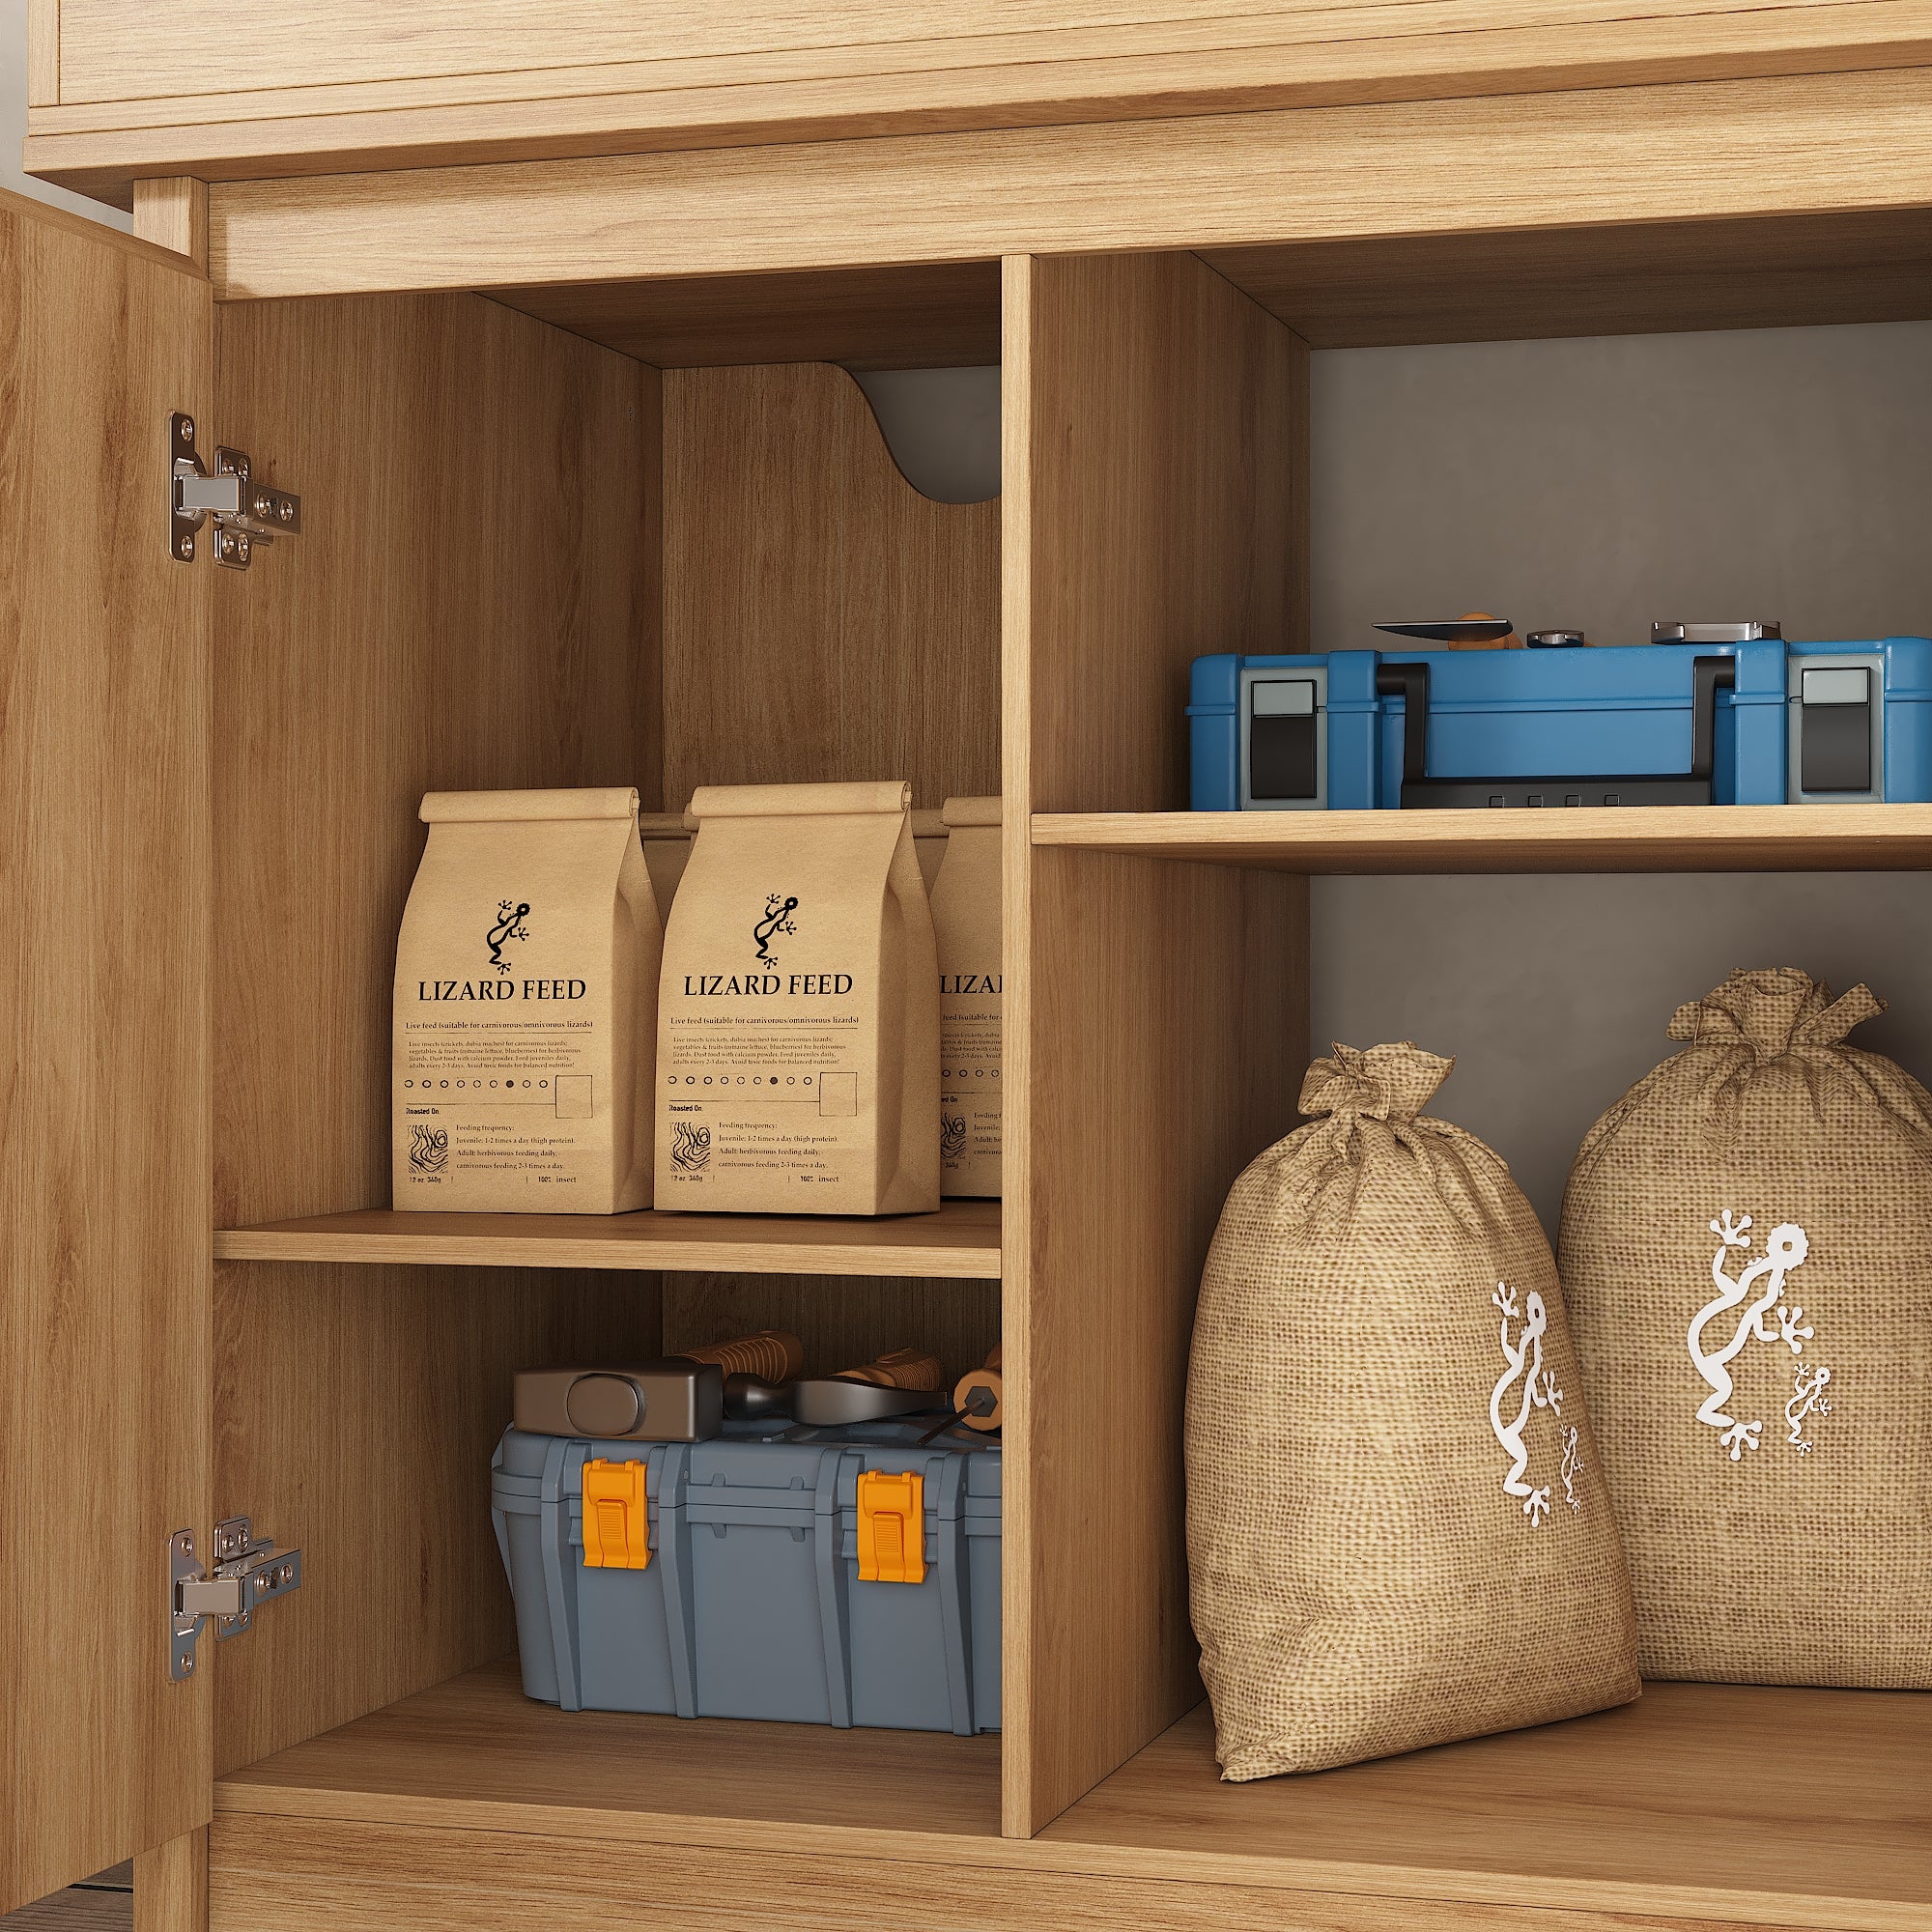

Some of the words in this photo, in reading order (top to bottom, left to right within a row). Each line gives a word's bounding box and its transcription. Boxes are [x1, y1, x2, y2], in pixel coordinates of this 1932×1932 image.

[418, 980, 515, 1001] LIZARD
[523, 980, 586, 1000] FEED
[684, 975, 781, 995] LIZARD
[788, 974, 853, 995] FEED
